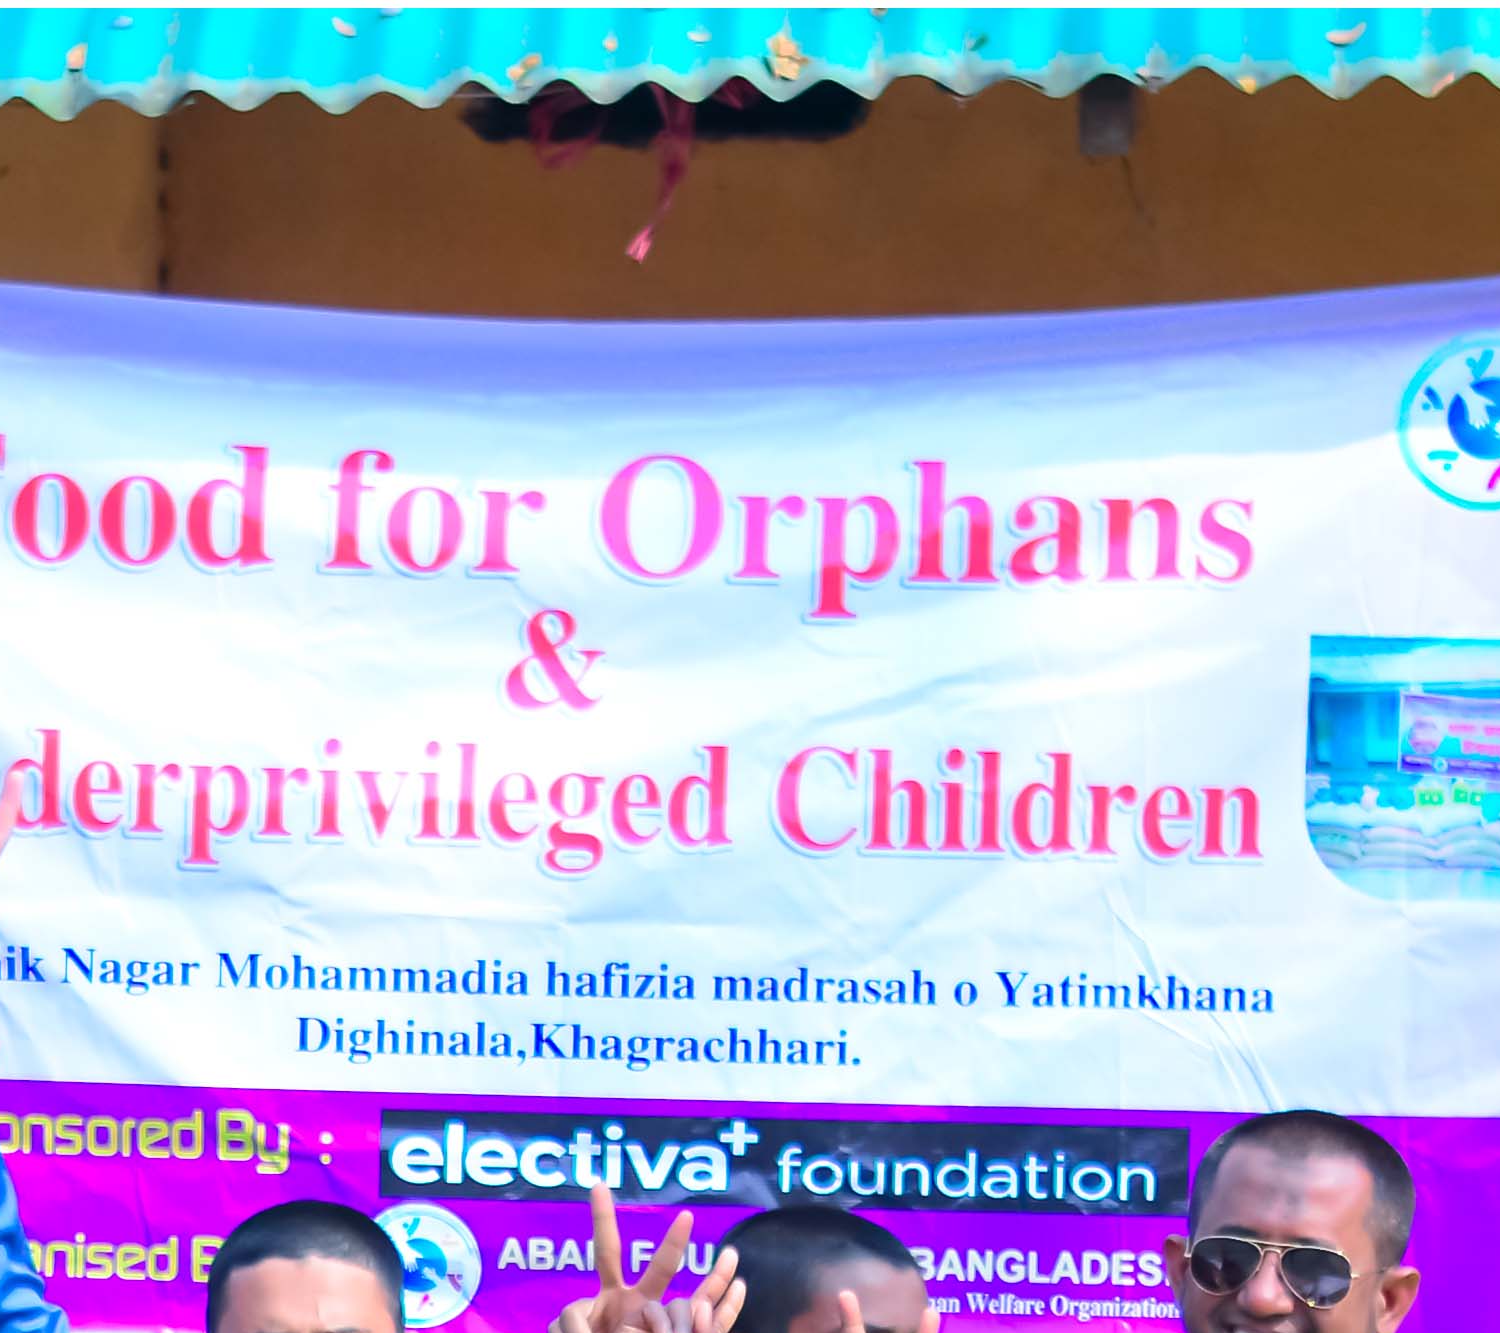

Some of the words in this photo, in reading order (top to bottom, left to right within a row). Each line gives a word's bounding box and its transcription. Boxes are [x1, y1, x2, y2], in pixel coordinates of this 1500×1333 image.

[323, 449, 547, 576] for
[599, 454, 1256, 619] Orphans
[504, 608, 606, 711] &
[774, 744, 1264, 859] Children
[60, 946, 200, 996] Nagar
[216, 951, 530, 998] Mohammadia
[546, 960, 696, 1000] hafizia
[712, 965, 937, 1006] madrasah
[953, 980, 979, 1007] o
[994, 969, 1275, 1014] Yatimkhana
[216, 1109, 292, 1175] By
[776, 1143, 1157, 1203] foundation
[29, 1232, 179, 1282] nised
[191, 1234, 226, 1283] B
[911, 1247, 1170, 1287] BANGLADES
[966, 1292, 1046, 1317] Welfare
[1051, 1294, 1181, 1321] Organization
